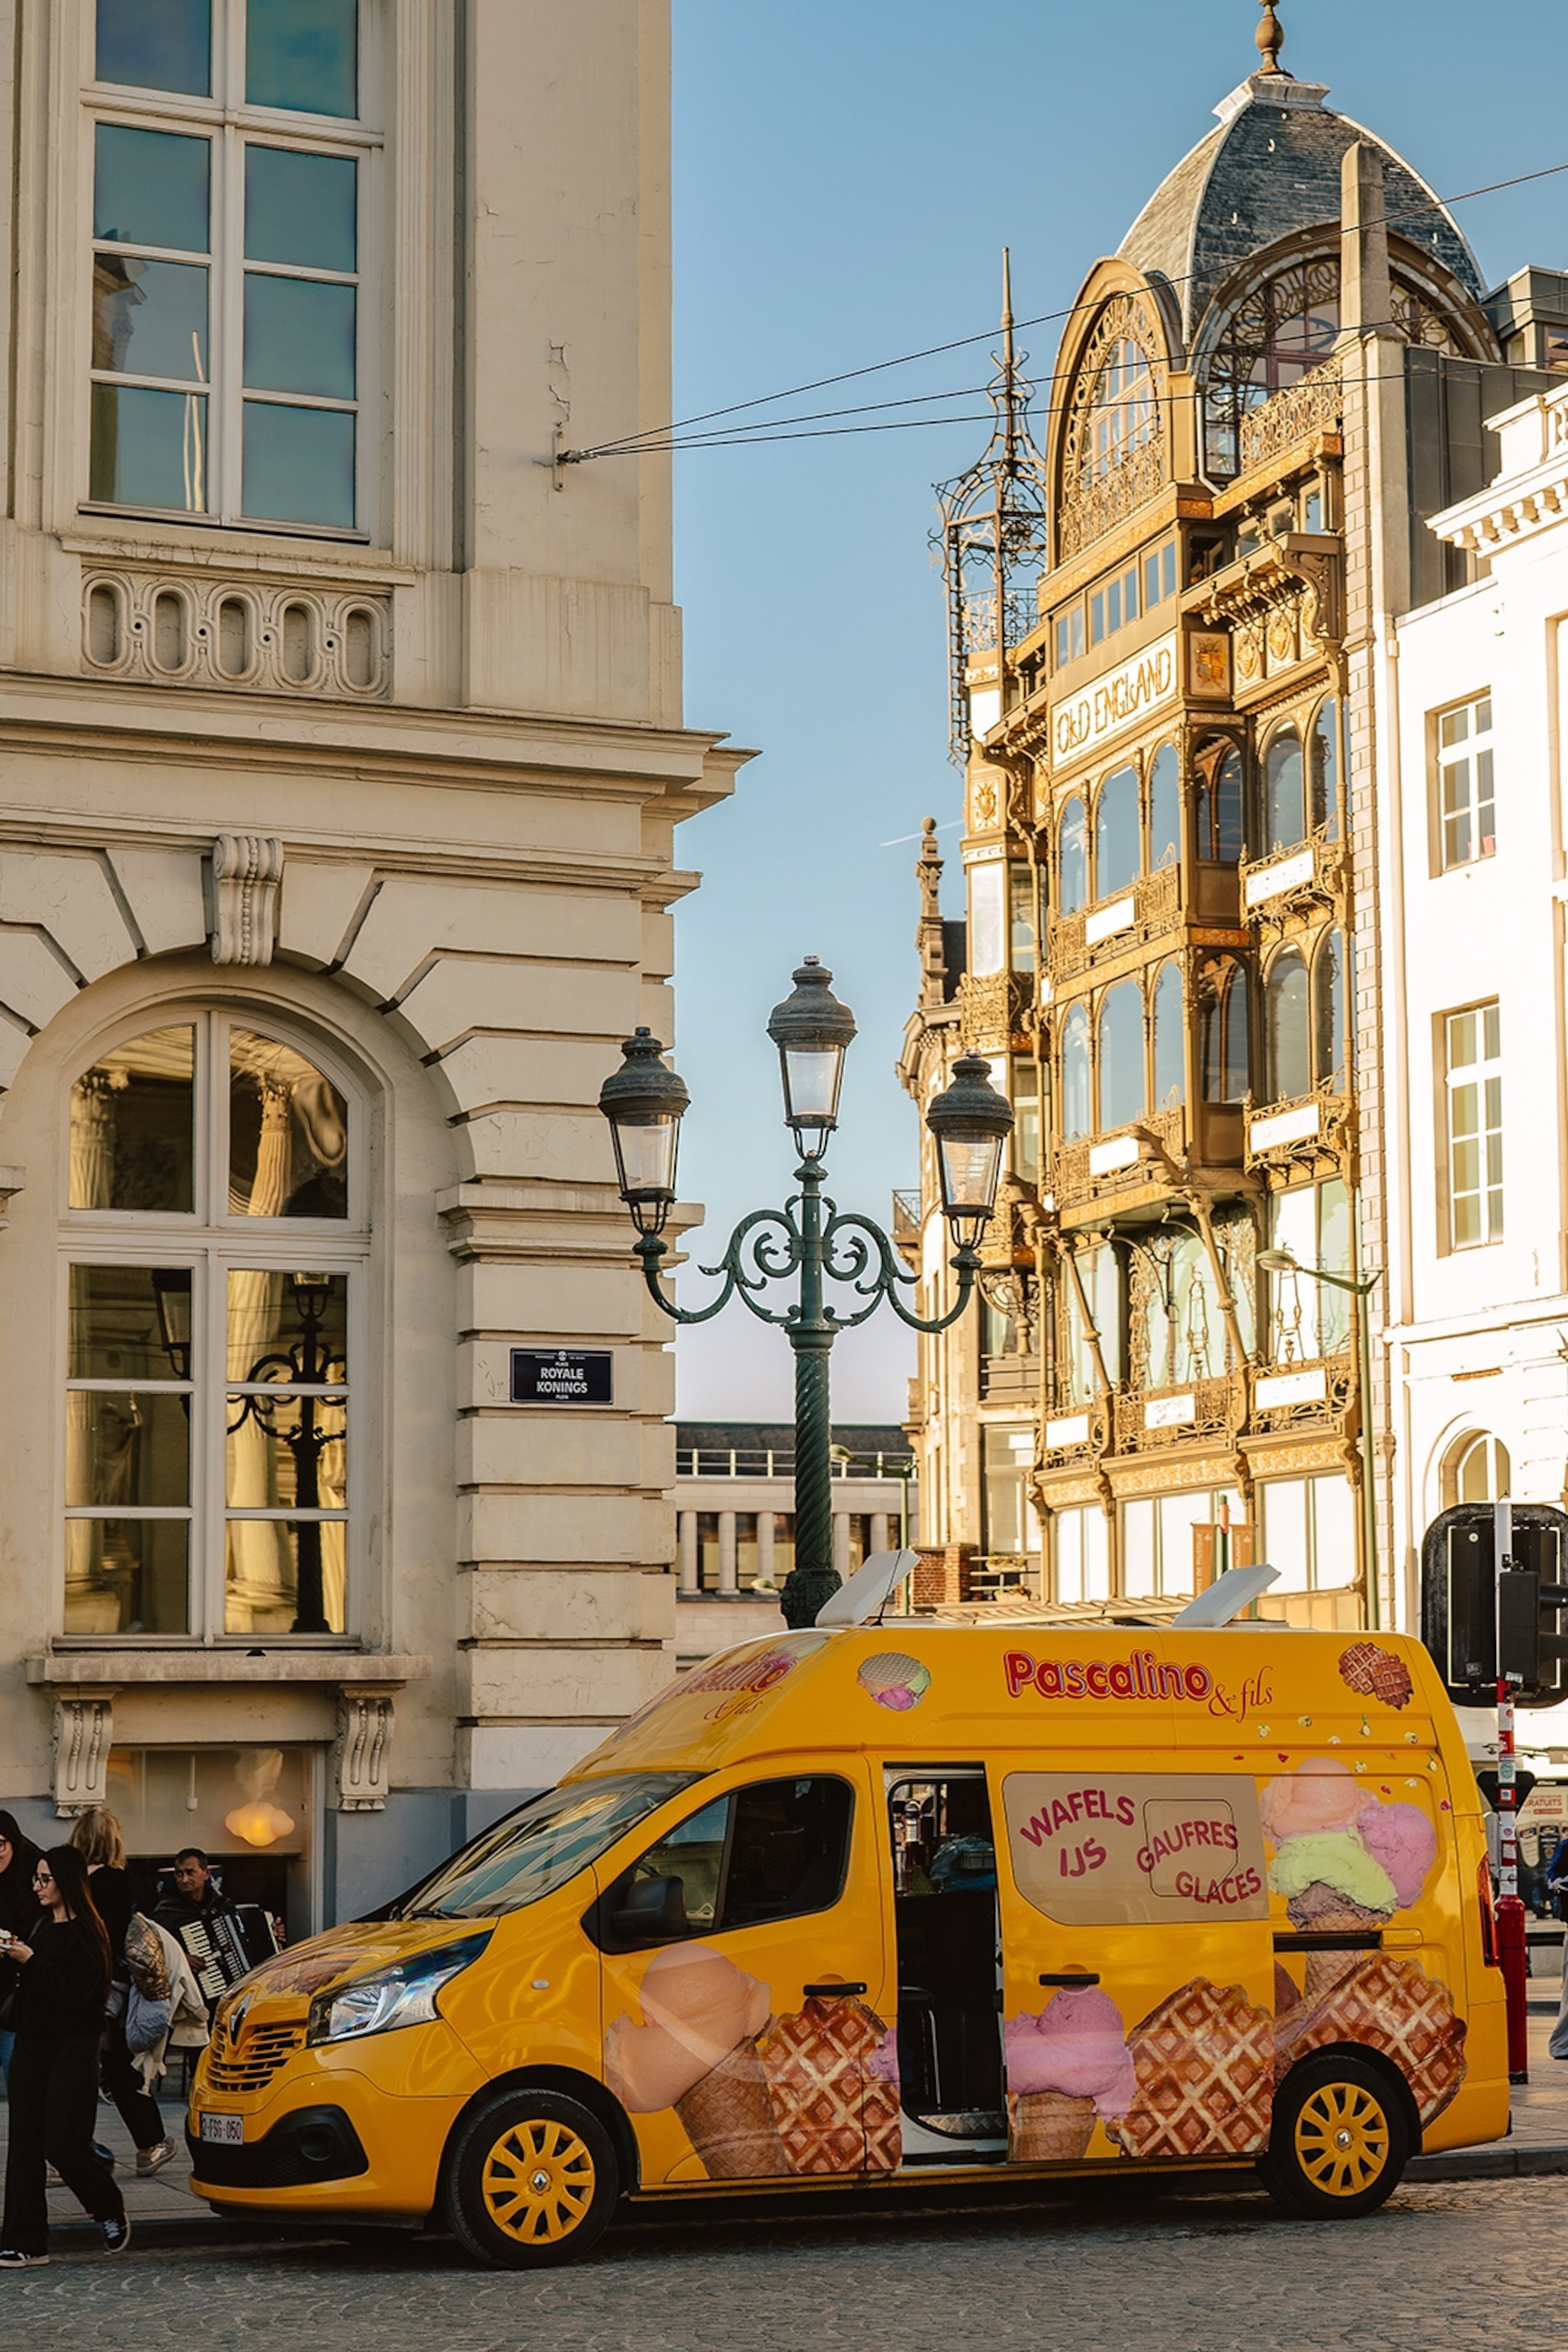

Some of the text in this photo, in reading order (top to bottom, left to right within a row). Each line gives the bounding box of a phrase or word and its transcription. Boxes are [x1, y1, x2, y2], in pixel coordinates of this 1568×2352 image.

[1057, 648, 1171, 754] OLD ENGLAND
[536, 1381, 588, 1393] KONINGS
[541, 1367, 584, 1380] ROYALE
[1004, 1648, 1274, 1723] Pascalino & fils
[1020, 1788, 1136, 1847] WAFELS
[1059, 1837, 1107, 1878] IJS
[1135, 1820, 1239, 1873] GAUFRES
[1175, 1867, 1263, 1905] GLACES
